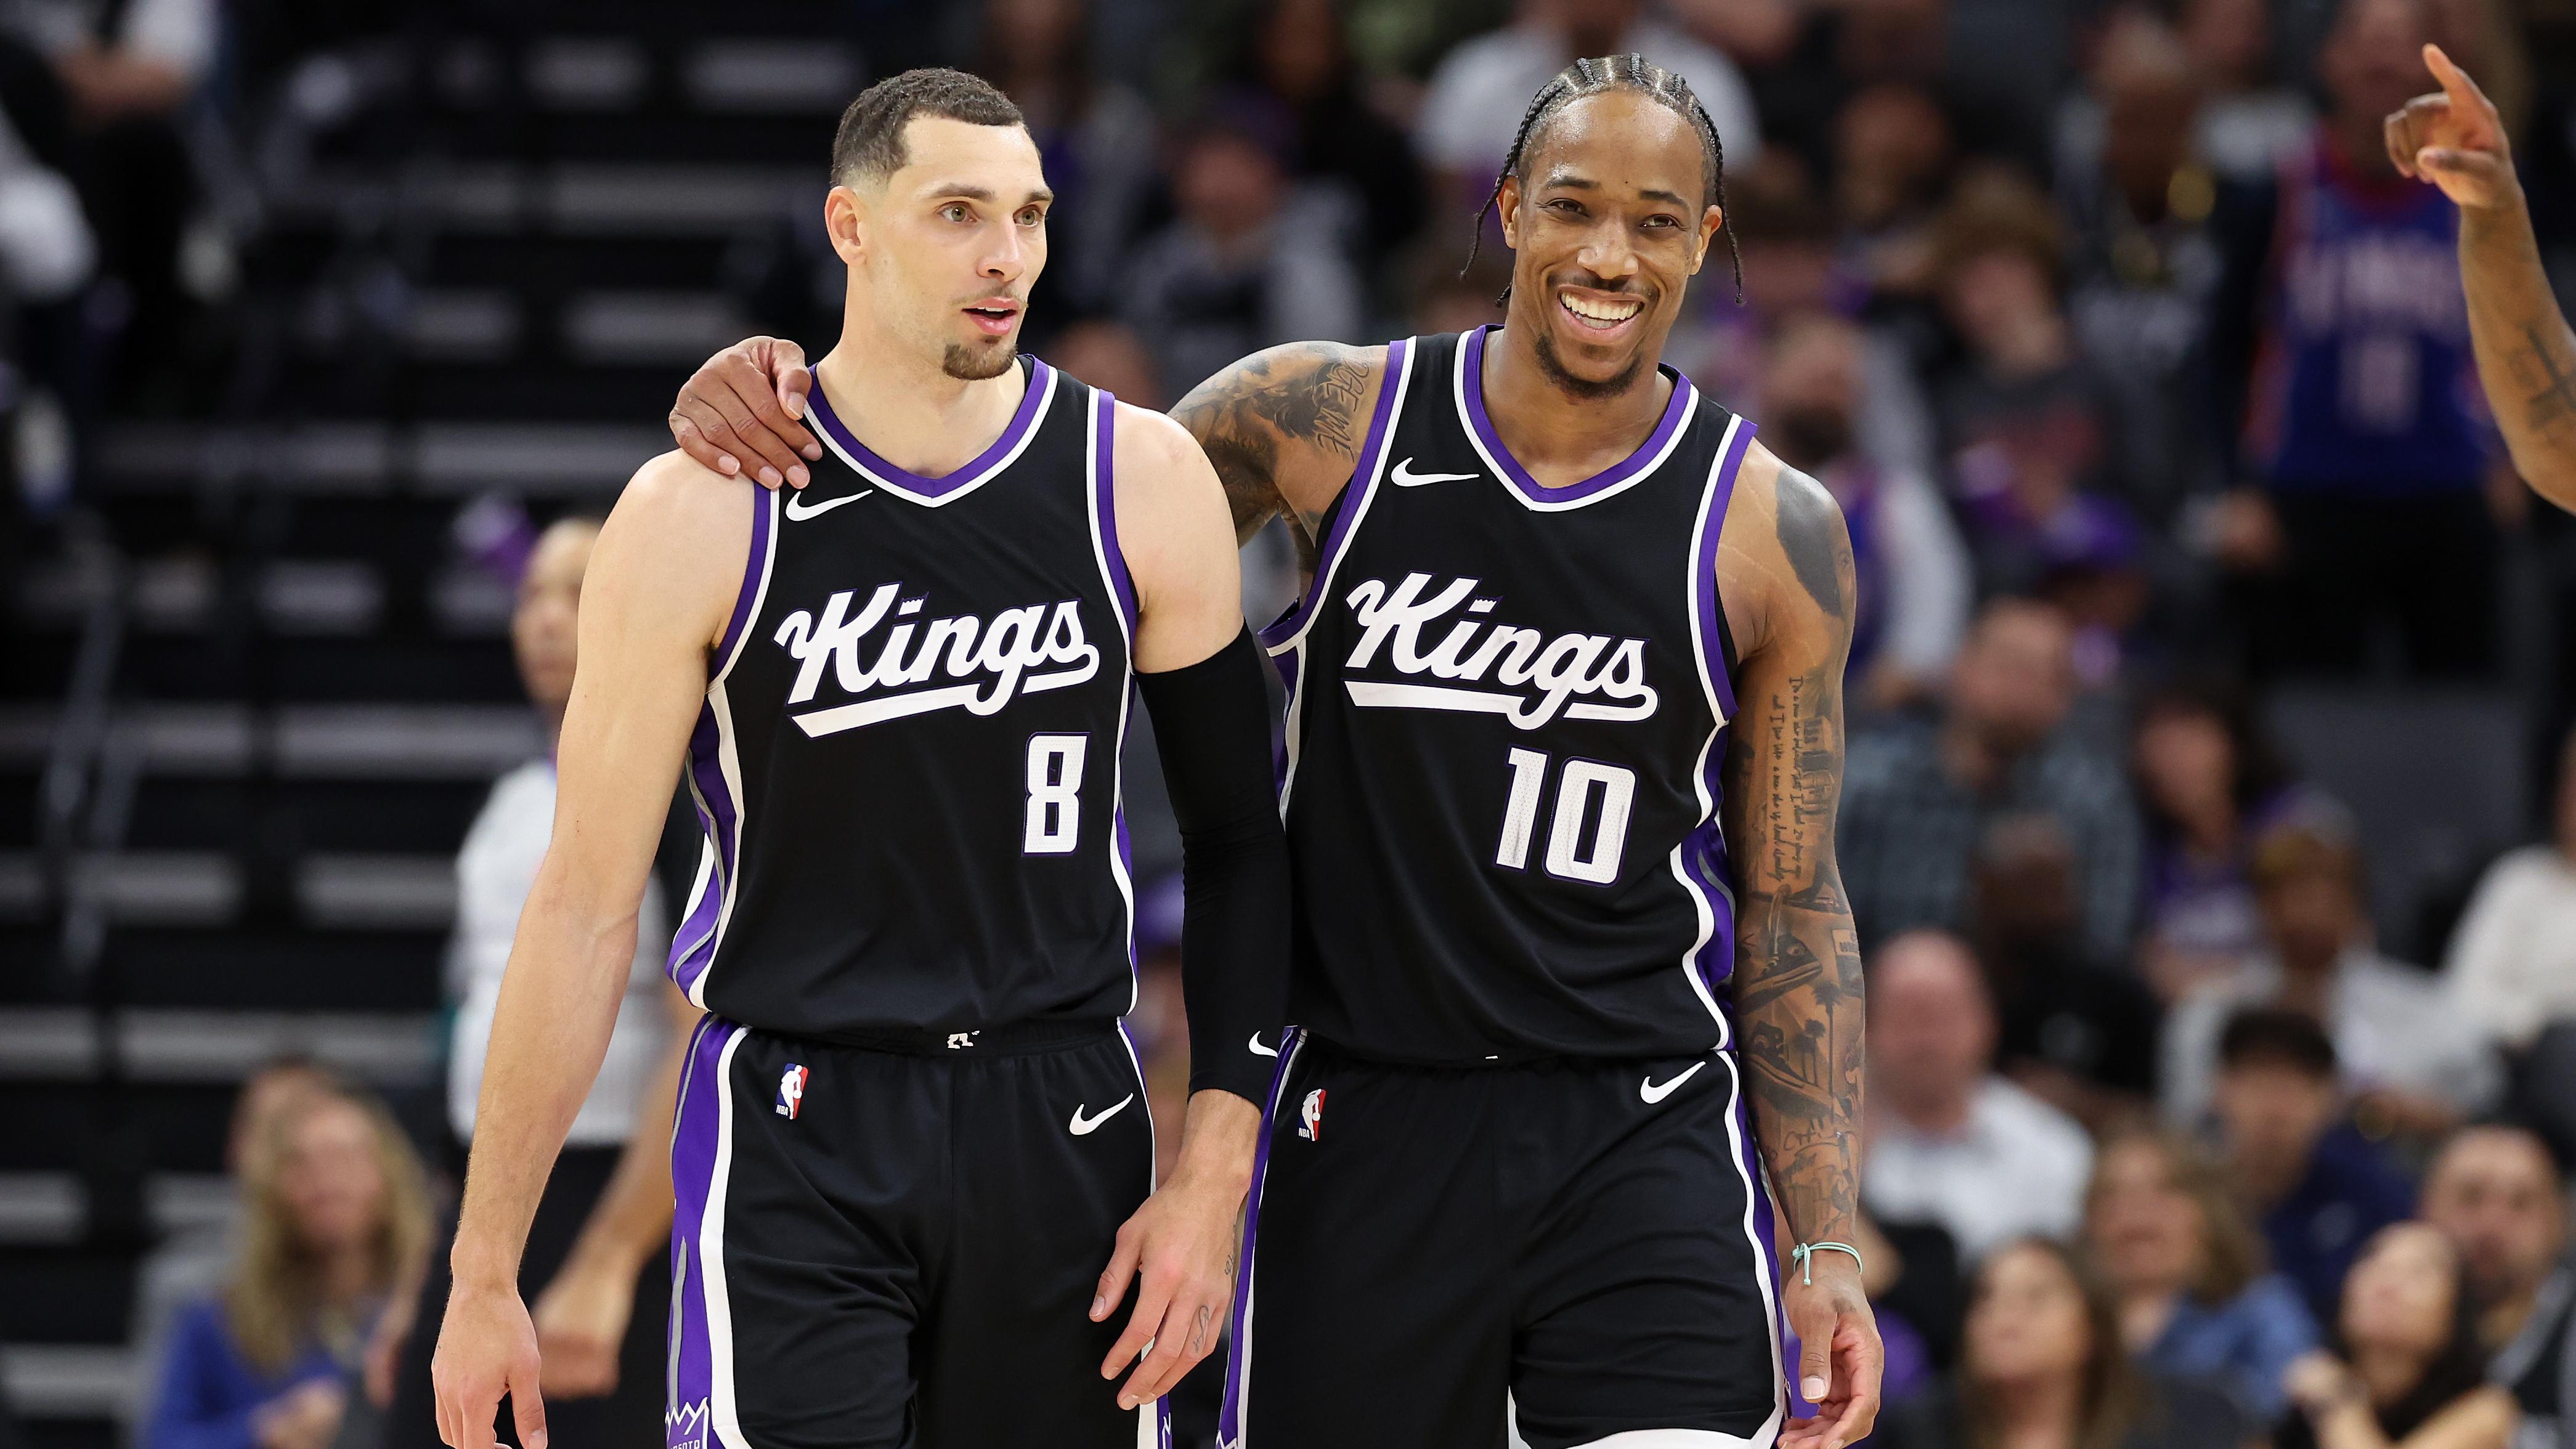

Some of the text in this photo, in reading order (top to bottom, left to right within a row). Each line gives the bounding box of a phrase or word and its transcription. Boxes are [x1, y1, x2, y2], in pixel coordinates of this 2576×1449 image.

[771, 581, 1100, 739] Kings
[1341, 570, 1661, 731] Kings
[1021, 732, 1091, 858] 8
[1492, 744, 1640, 888] 10
[776, 1105, 788, 1116] NBA
[1299, 1127, 1310, 1138] NBA
